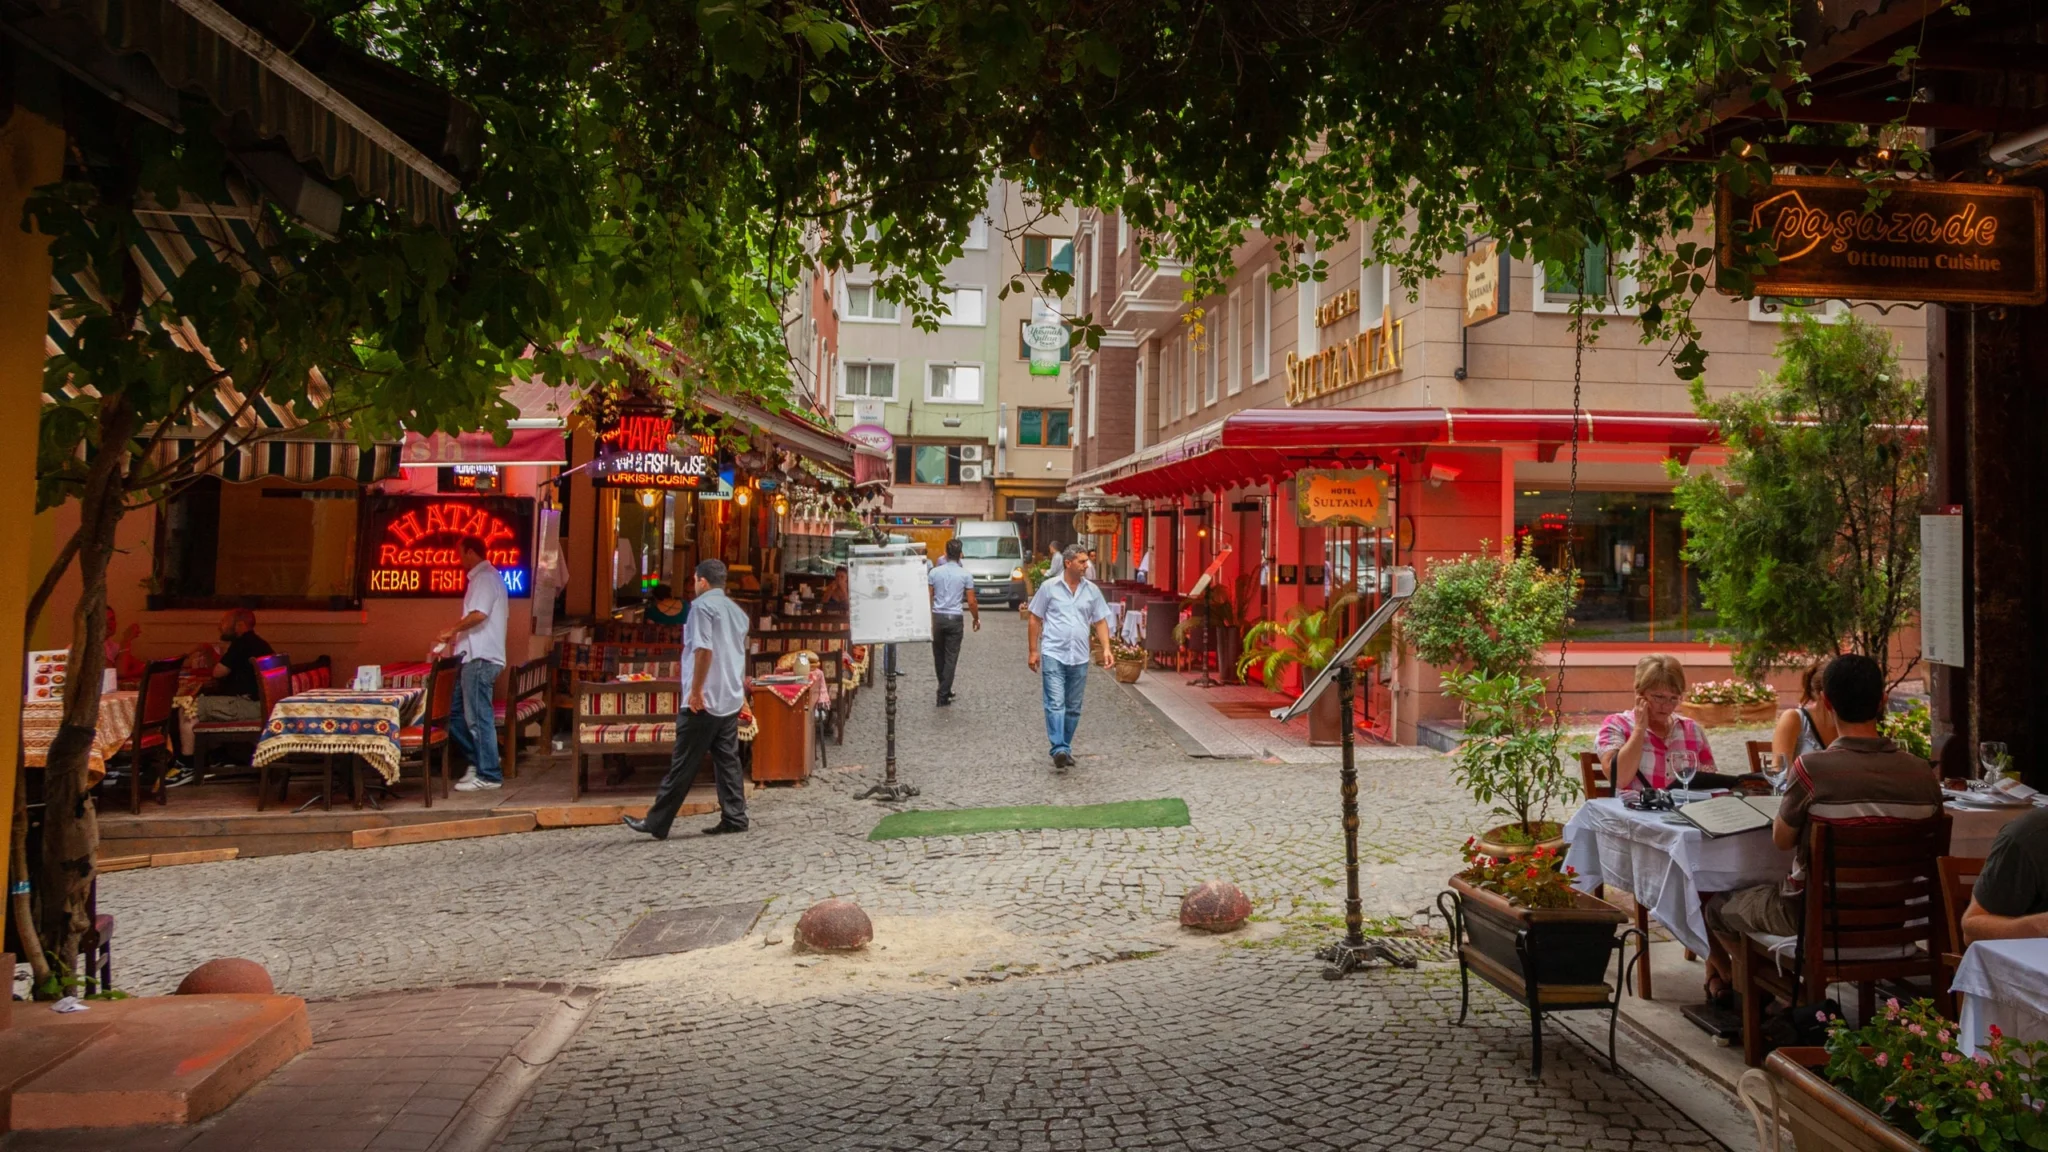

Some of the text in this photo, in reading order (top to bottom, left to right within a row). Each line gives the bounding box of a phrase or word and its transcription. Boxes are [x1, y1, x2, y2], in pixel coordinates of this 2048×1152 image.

[1847, 251, 2001, 272] Ottoman Cuisine
[1315, 288, 1360, 329] HOTEL
[1285, 304, 1404, 408] SULTANIA
[619, 416, 672, 452] HATAY
[644, 453, 668, 474] FISH
[607, 473, 654, 484] TURKISH
[1313, 498, 1374, 508] SULTANIA
[388, 504, 515, 546] HATAY
[370, 570, 420, 591] KEBAB
